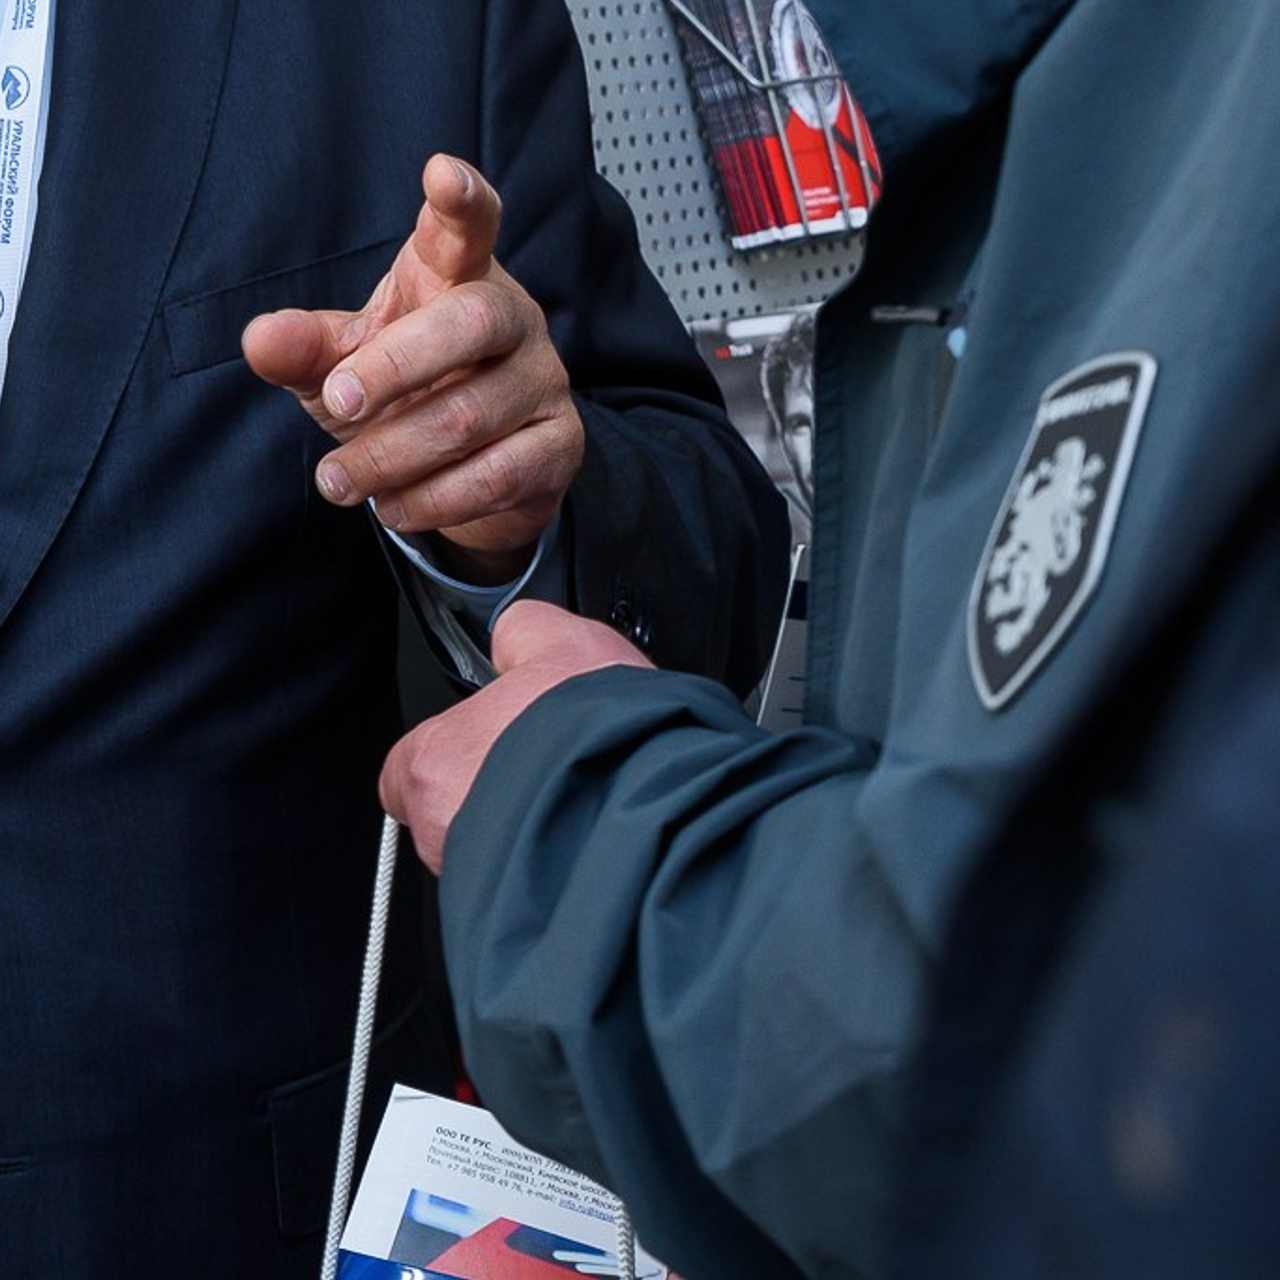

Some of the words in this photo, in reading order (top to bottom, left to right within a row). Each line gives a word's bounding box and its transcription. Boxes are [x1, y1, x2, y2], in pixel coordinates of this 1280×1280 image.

[6, 120, 23, 195] УРАЛЬСКИЙ
[1, 198, 14, 244] ФОРУМ
[436, 1127, 457, 1138] ООО
[461, 1134, 470, 1142] ТЕ
